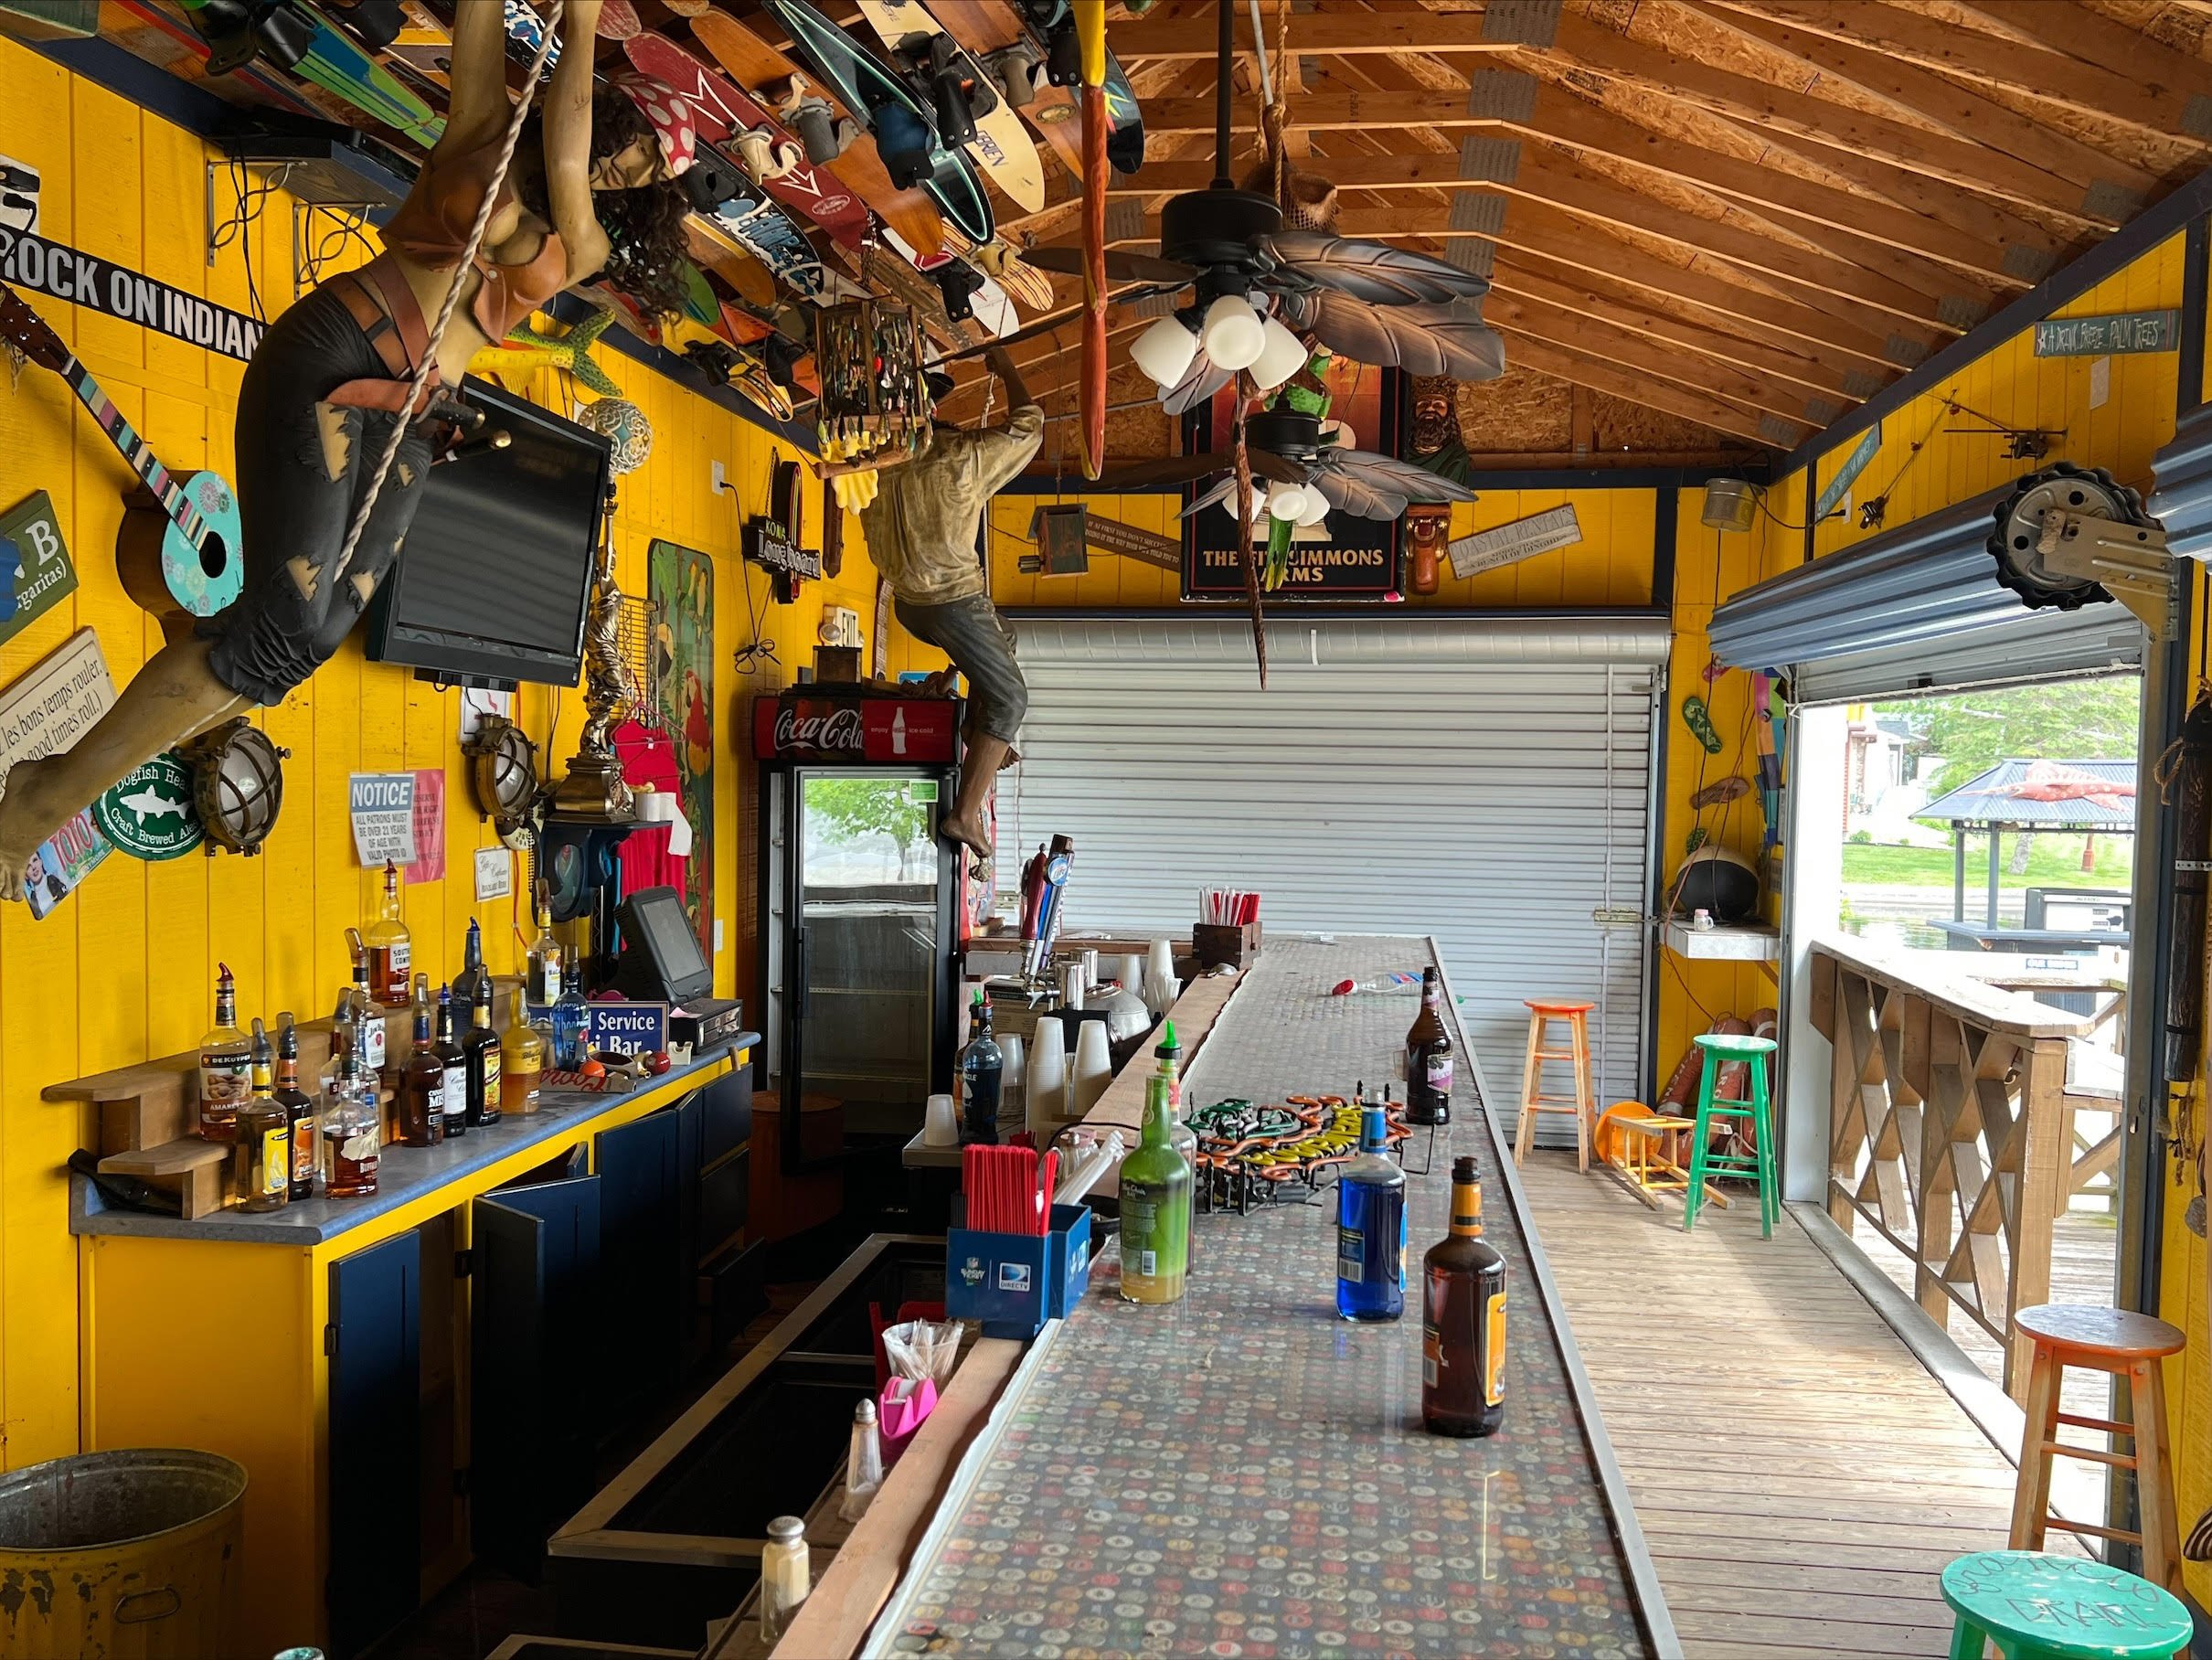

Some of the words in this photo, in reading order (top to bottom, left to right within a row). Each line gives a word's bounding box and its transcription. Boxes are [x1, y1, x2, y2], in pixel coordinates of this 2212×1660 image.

[0, 229, 101, 307] ROCK
[110, 270, 157, 327] ON
[2110, 318, 2131, 349] PALM
[2134, 318, 2158, 349] TREES
[765, 519, 786, 540] KONA
[1452, 529, 1513, 559] COASTAL
[1515, 510, 1574, 539] RENTALS
[1203, 550, 1239, 567] THE
[1252, 548, 1384, 567] FITSIMMONS
[16, 557, 68, 611] rgaritas)
[1, 726, 20, 749] les
[17, 708, 44, 736] bons
[43, 685, 74, 718] temps
[73, 657, 102, 695] rouler.
[52, 714, 80, 746] times
[773, 708, 864, 751] Coca-Cola
[116, 766, 159, 793] Dogfish
[165, 769, 191, 793] Hea
[352, 782, 410, 807] NOTICE
[111, 807, 134, 836] Craft
[138, 827, 175, 846] Brewed
[356, 815, 367, 825] ALL
[367, 814, 391, 825] PATRONS
[392, 813, 408, 824] MUST
[358, 827, 367, 837] BE
[367, 826, 381, 836] OVER
[382, 825, 389, 835] 21
[390, 825, 407, 835] YEARS
[49, 813, 92, 871] TOTO
[367, 850, 383, 860] VALID
[383, 848, 400, 859] PHOTO
[400, 847, 407, 857] ID
[368, 838, 376, 848] OF
[377, 837, 388, 847] AGE
[598, 1011, 654, 1030] Service
[610, 1035, 643, 1055] Bar
[1000, 1282, 1028, 1290] DIRECTV
